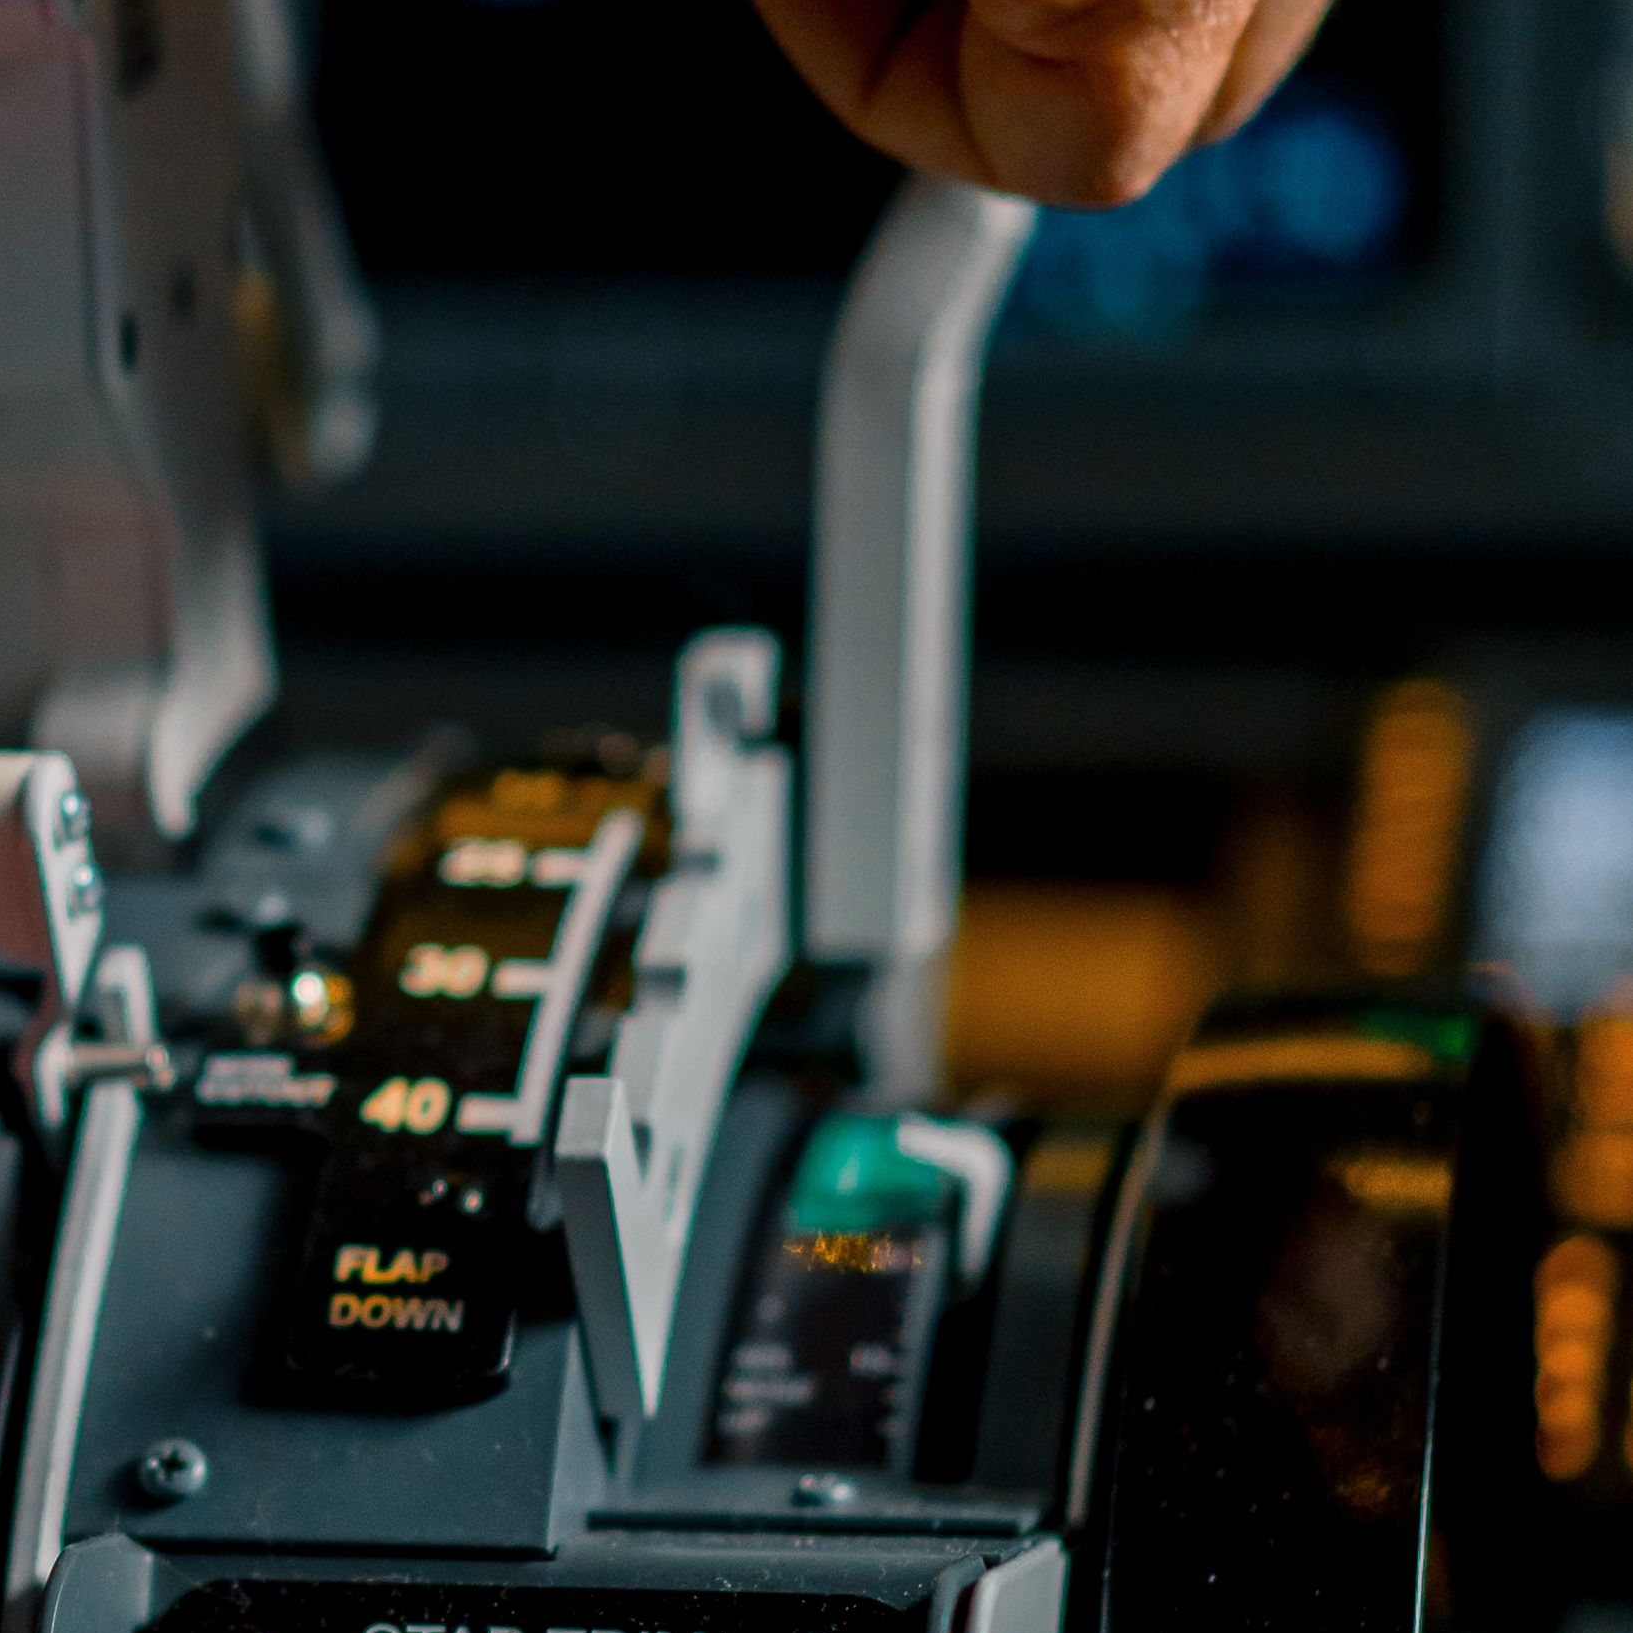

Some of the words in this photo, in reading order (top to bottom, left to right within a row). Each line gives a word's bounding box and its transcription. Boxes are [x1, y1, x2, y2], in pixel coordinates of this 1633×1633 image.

[362, 1077, 452, 1134] 40
[335, 1246, 449, 1286] FLAP
[328, 1294, 465, 1334] DOWN
